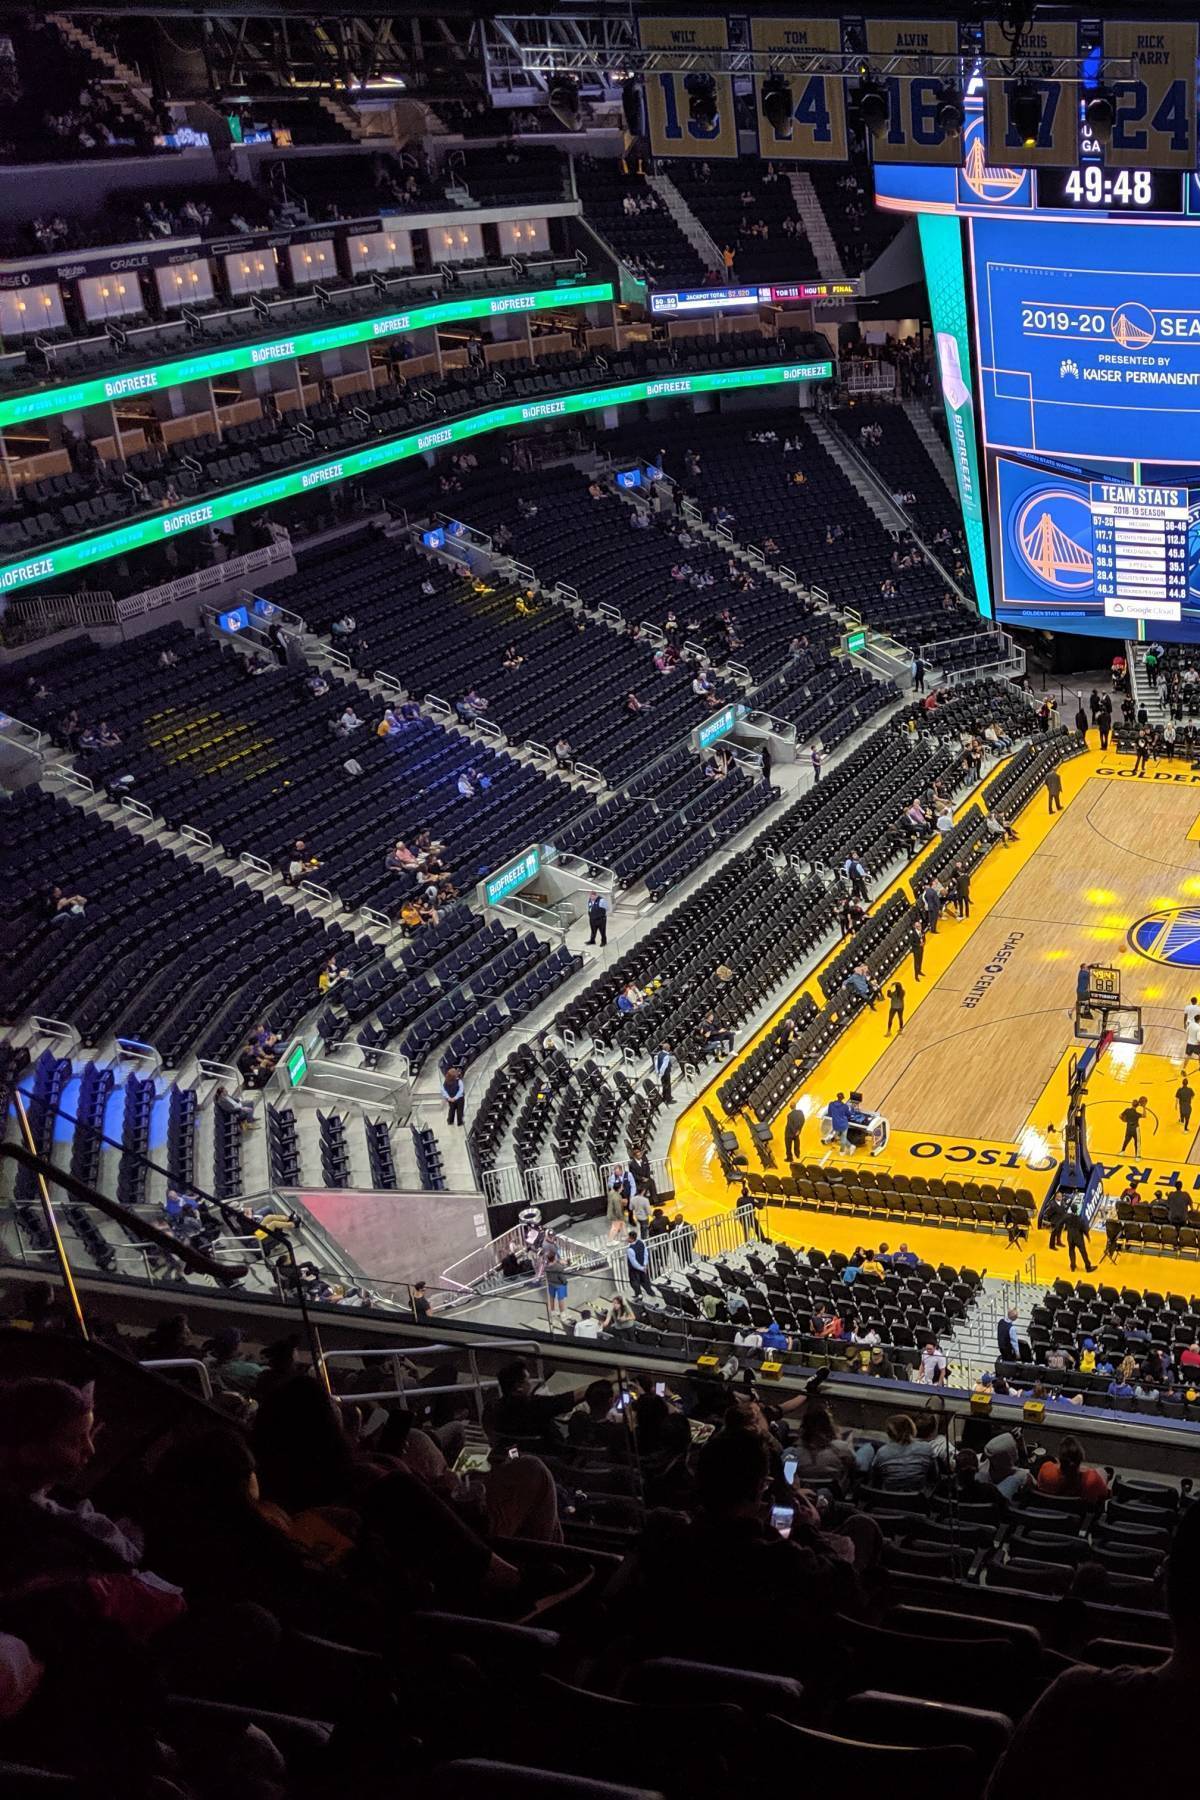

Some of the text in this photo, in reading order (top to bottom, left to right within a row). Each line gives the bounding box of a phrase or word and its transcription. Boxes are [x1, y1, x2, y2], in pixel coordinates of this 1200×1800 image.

[670, 30, 696, 43] WILT
[784, 31, 808, 44] TOM
[896, 33, 929, 47] ALVIN
[1137, 35, 1165, 49] RICK
[886, 77, 948, 146] 16
[1111, 79, 1189, 151] 24
[1065, 165, 1151, 203] 49:48
[110, 256, 150, 270] ORACLE
[804, 287, 817, 295] HOU
[832, 285, 853, 293] FINAL
[1021, 310, 1106, 334] 2019-20
[1098, 353, 1171, 366] PRESENTED BY
[1083, 367, 1122, 383] KAISER
[1101, 485, 1179, 506] TEAM STATS
[1140, 507, 1166, 517] SEASON
[1094, 529, 1113, 540] 117.7
[959, 931, 1025, 1010] CHASE CENTER
[1085, 1181, 1103, 1221] thrive
